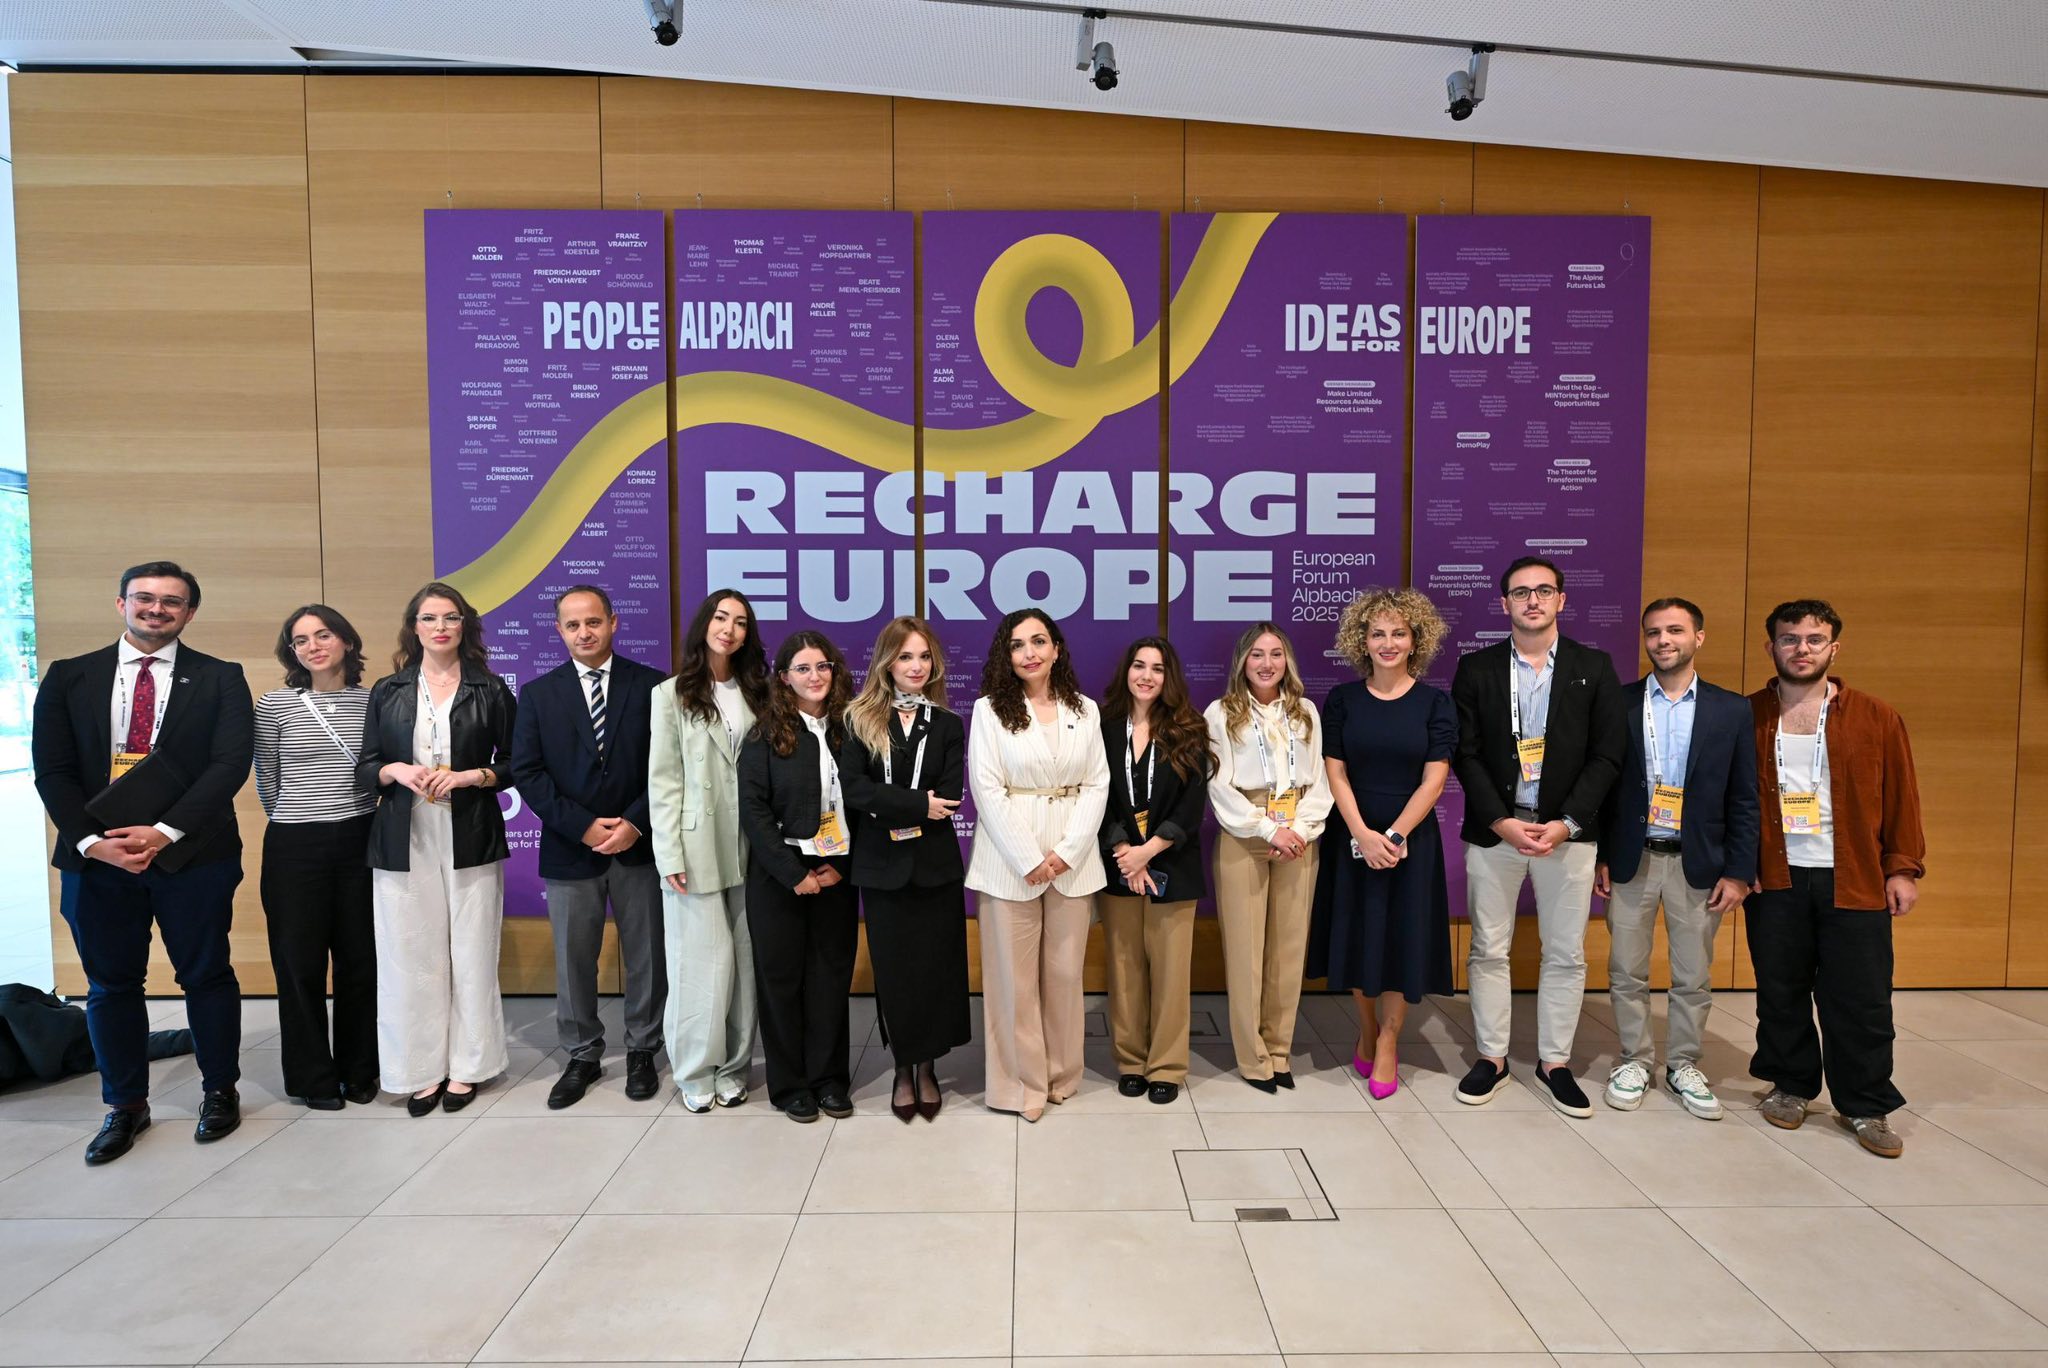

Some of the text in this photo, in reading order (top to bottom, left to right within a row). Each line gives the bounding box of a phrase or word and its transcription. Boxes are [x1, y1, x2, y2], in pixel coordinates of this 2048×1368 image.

[543, 301, 659, 350] PEOPLE
[680, 301, 792, 350] ALPBACH
[1286, 304, 1400, 351] IDEAS
[1421, 306, 1530, 354] EUROPE
[627, 338, 659, 350] OF
[1352, 340, 1400, 352] FOR
[705, 470, 1376, 537] RECHARGE
[1293, 550, 1375, 567] European
[707, 547, 1273, 622] EUROPE
[1293, 569, 1349, 584] Forum
[1292, 587, 1363, 605] Alpbach
[1292, 606, 1339, 621] 2025
